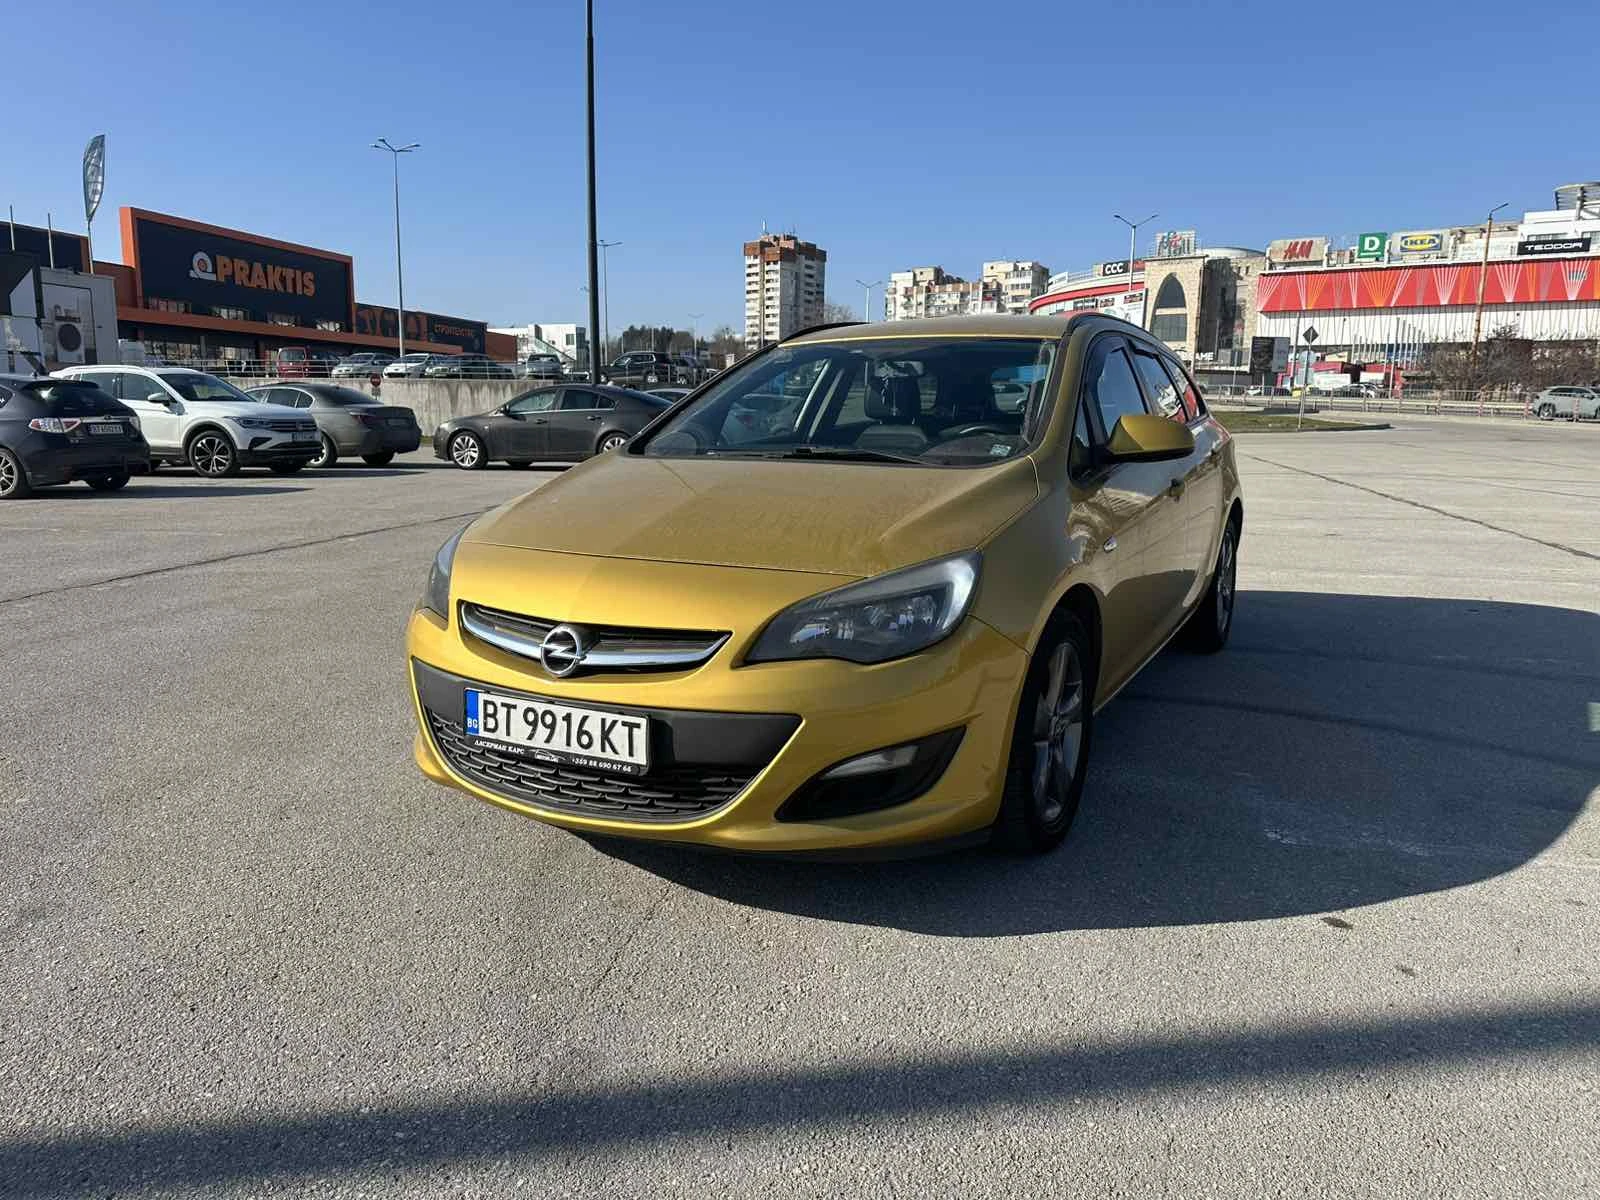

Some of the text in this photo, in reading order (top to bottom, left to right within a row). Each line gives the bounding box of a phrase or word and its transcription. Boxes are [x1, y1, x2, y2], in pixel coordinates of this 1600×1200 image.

[1364, 236, 1380, 251] D
[1403, 234, 1438, 248] IKEA
[1105, 263, 1123, 274] CCC
[216, 255, 315, 297] PRAKTIS
[467, 717, 478, 728] BG
[483, 699, 641, 757] BT 9916 KT
